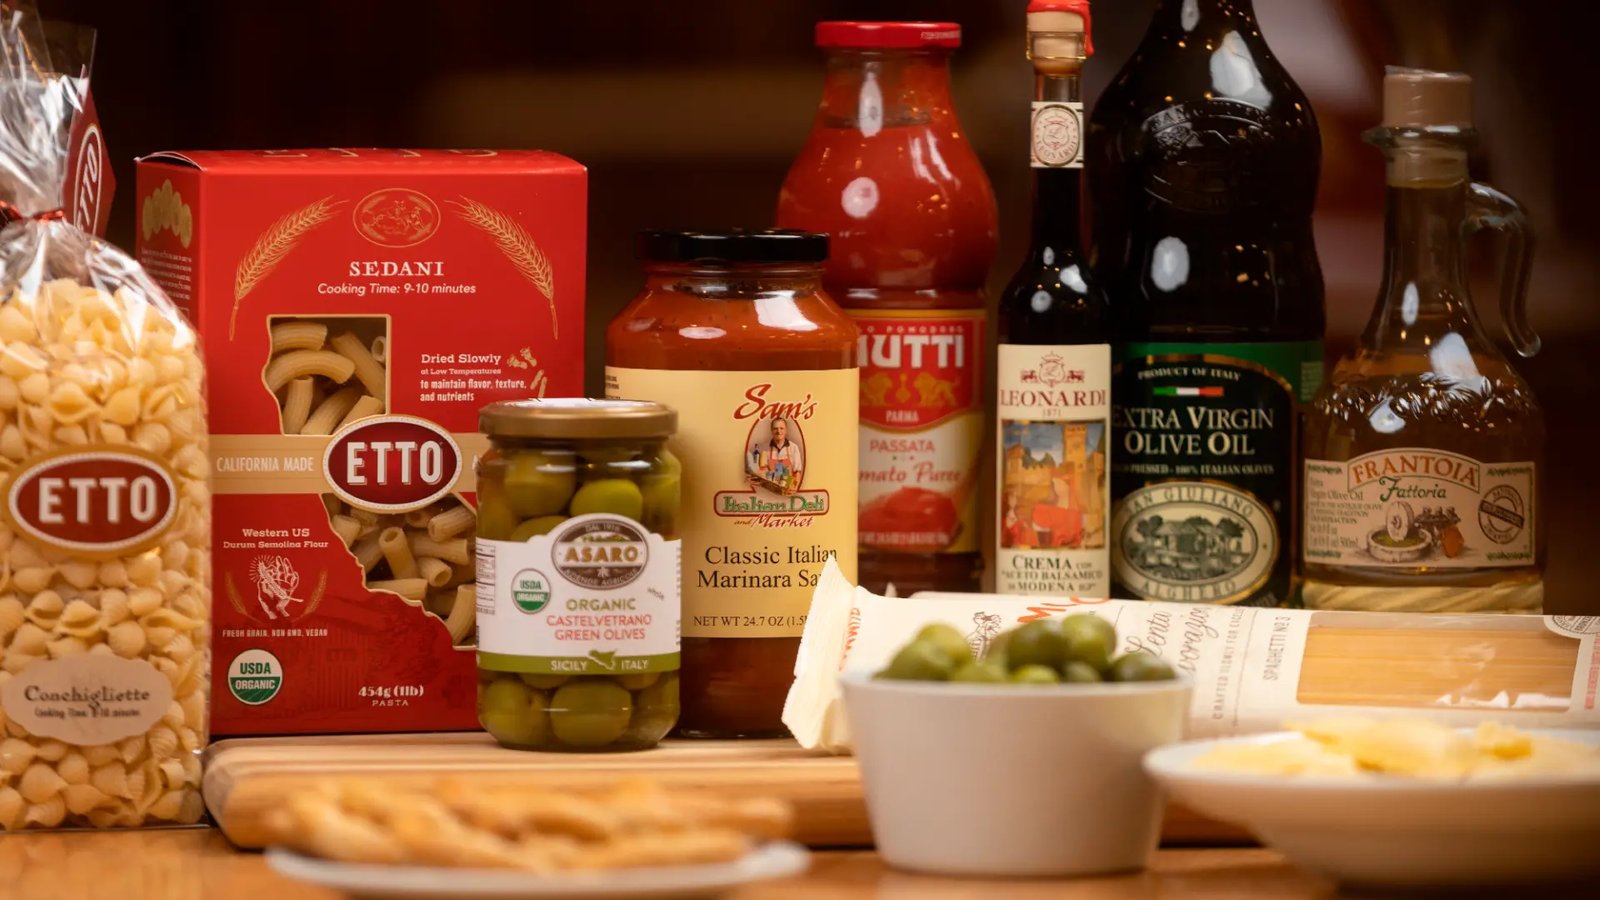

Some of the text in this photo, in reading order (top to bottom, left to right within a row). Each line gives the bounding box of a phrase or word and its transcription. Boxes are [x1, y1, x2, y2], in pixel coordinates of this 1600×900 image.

[349, 261, 444, 277] SEDANI
[318, 283, 477, 297] Cooking Time: 9-10 minutes
[421, 353, 502, 365] Dried Slowly
[1138, 367, 1241, 381] PRODUCT OF ITALY
[420, 380, 429, 389] to
[431, 379, 466, 389] maintain
[420, 392, 475, 402] and nutrients
[734, 384, 817, 420] Sam's
[1000, 389, 1107, 407] LEONARDI
[885, 410, 920, 422] PARMA
[1112, 406, 1274, 429] EXTRA VIRGIN
[870, 439, 935, 452] PASSATA
[1124, 431, 1255, 455] OLIVE OIL
[216, 457, 315, 472] CALIFORNIA MADE
[346, 440, 444, 486] ETTO
[1200, 465, 1242, 475] ITALIAN
[858, 466, 907, 482] mato
[1353, 455, 1477, 487] FRANTOIA
[1379, 476, 1447, 501] Fattoria
[39, 475, 157, 525] ETTO
[723, 495, 825, 513] Italian Deli
[1163, 485, 1254, 518] GIULIANO
[752, 513, 813, 528] Market
[242, 528, 310, 537] Western US
[565, 546, 639, 562] ASARO
[705, 546, 780, 564] Classic
[1012, 554, 1072, 570] CREMA
[520, 581, 542, 589] USDA
[697, 570, 792, 588] Marinara
[1018, 581, 1075, 592] MODENA
[1142, 579, 1237, 601] ALGHERO
[566, 598, 637, 612] ORGANIC
[546, 614, 653, 627] CASTELVETRANO
[693, 616, 718, 627] NET
[721, 616, 741, 627] WT
[743, 616, 765, 627] 24.7
[768, 615, 784, 627] OZ
[222, 629, 245, 638] FRESH
[272, 629, 286, 638] NON
[306, 629, 328, 638] VEGAN
[554, 628, 646, 641] GREEN OLIVES
[1263, 633, 1286, 681] SPAGHETTI
[240, 662, 272, 675] USDA
[550, 659, 648, 672] SICILY ITALY
[235, 680, 276, 691] ORGANIC
[358, 686, 391, 699] 454g
[24, 685, 150, 712] Conchigliette
[35, 707, 65, 720] Cooking
[112, 708, 141, 718] minutes
